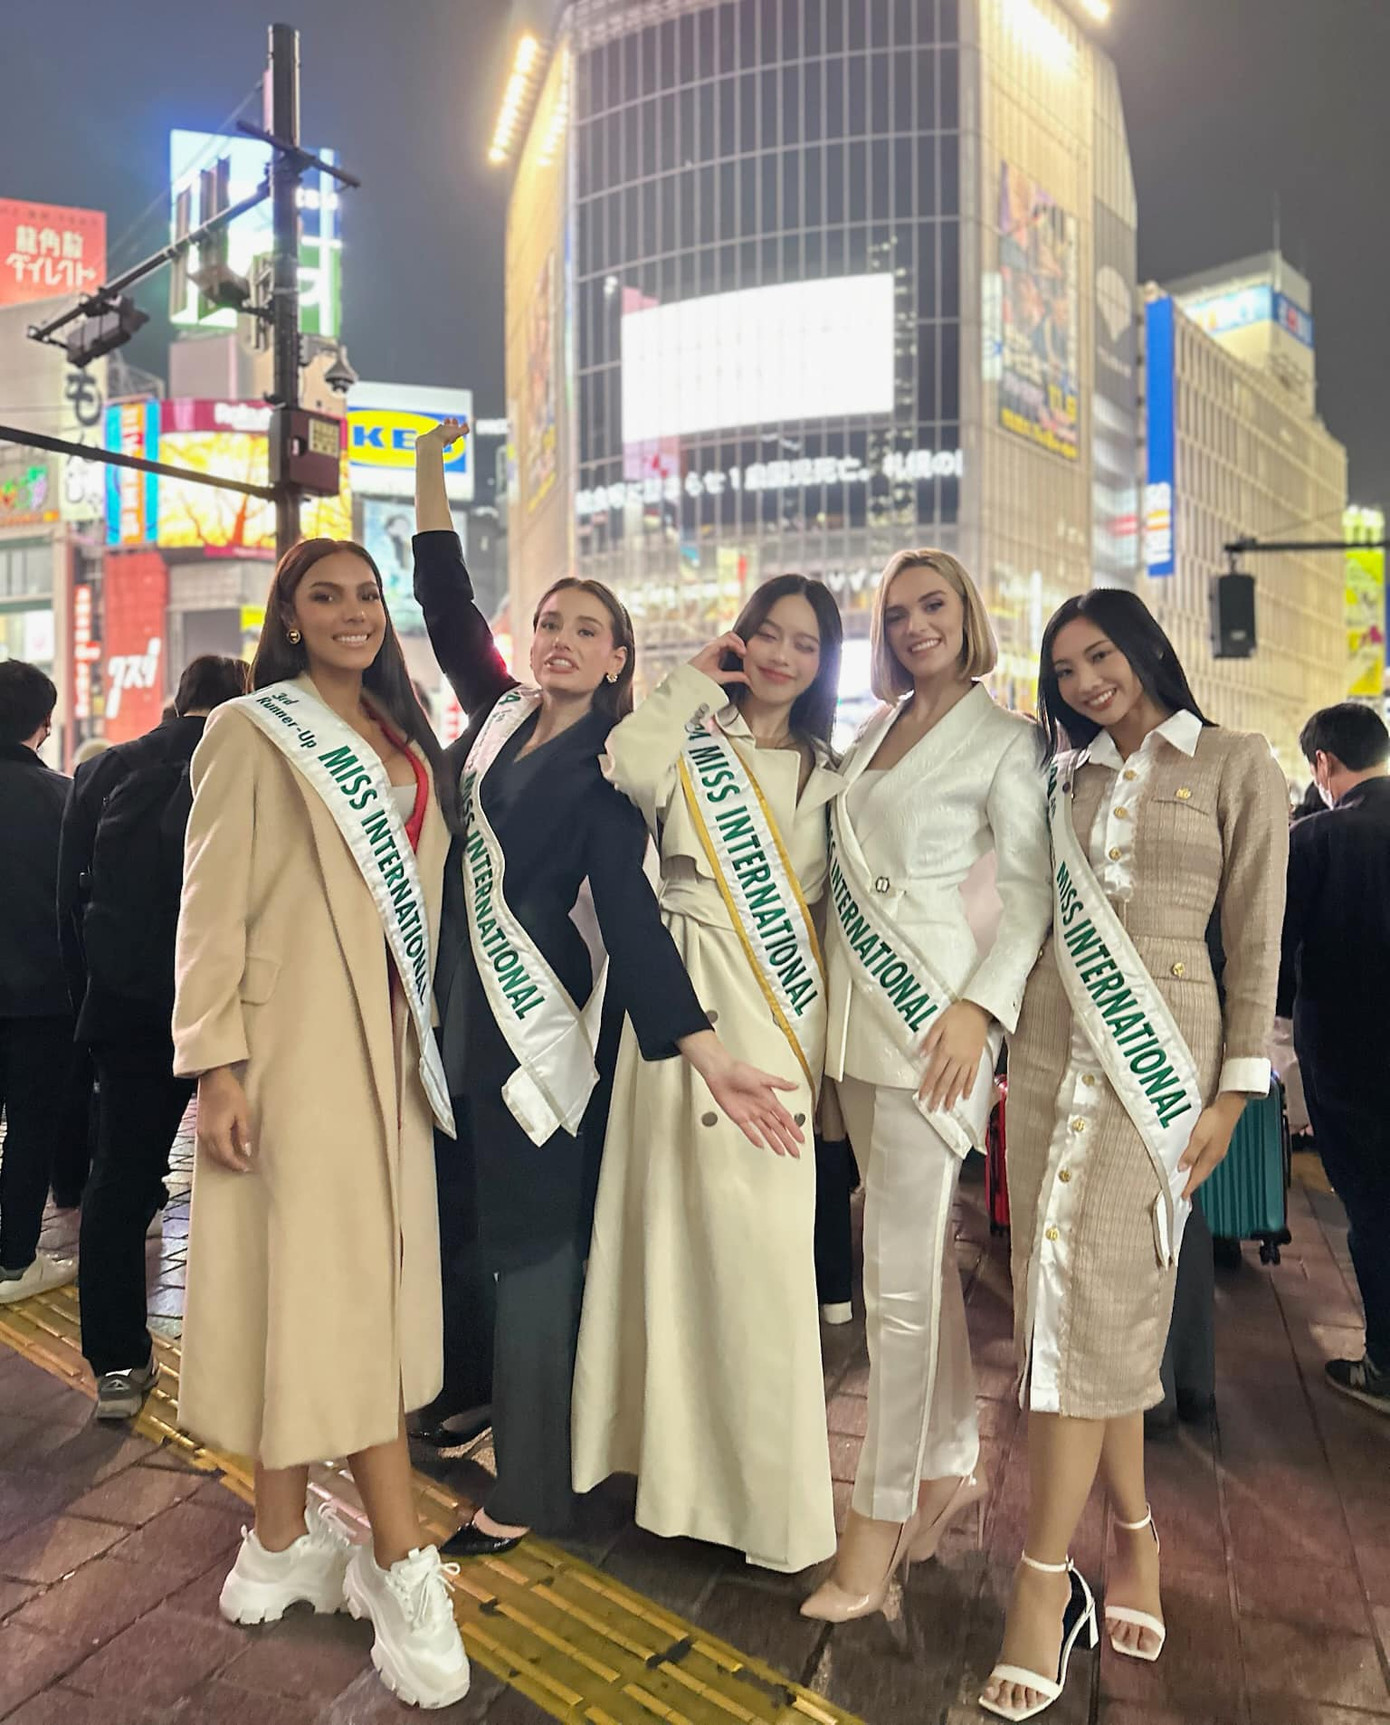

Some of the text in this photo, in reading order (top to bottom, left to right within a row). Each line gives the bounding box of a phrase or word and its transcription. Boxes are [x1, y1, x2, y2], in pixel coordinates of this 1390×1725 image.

[256, 696, 317, 749] Runner-Up
[271, 692, 299, 706] 3rd
[318, 745, 431, 1006] MISS INTERNATIONAL
[466, 829, 546, 1020] INTERNATIONAL
[688, 745, 818, 1017] MISS INTERNATIONAL
[831, 857, 938, 1033] INTERNATIONAL
[1056, 860, 1192, 1129] MISS INTERNATIONAL
